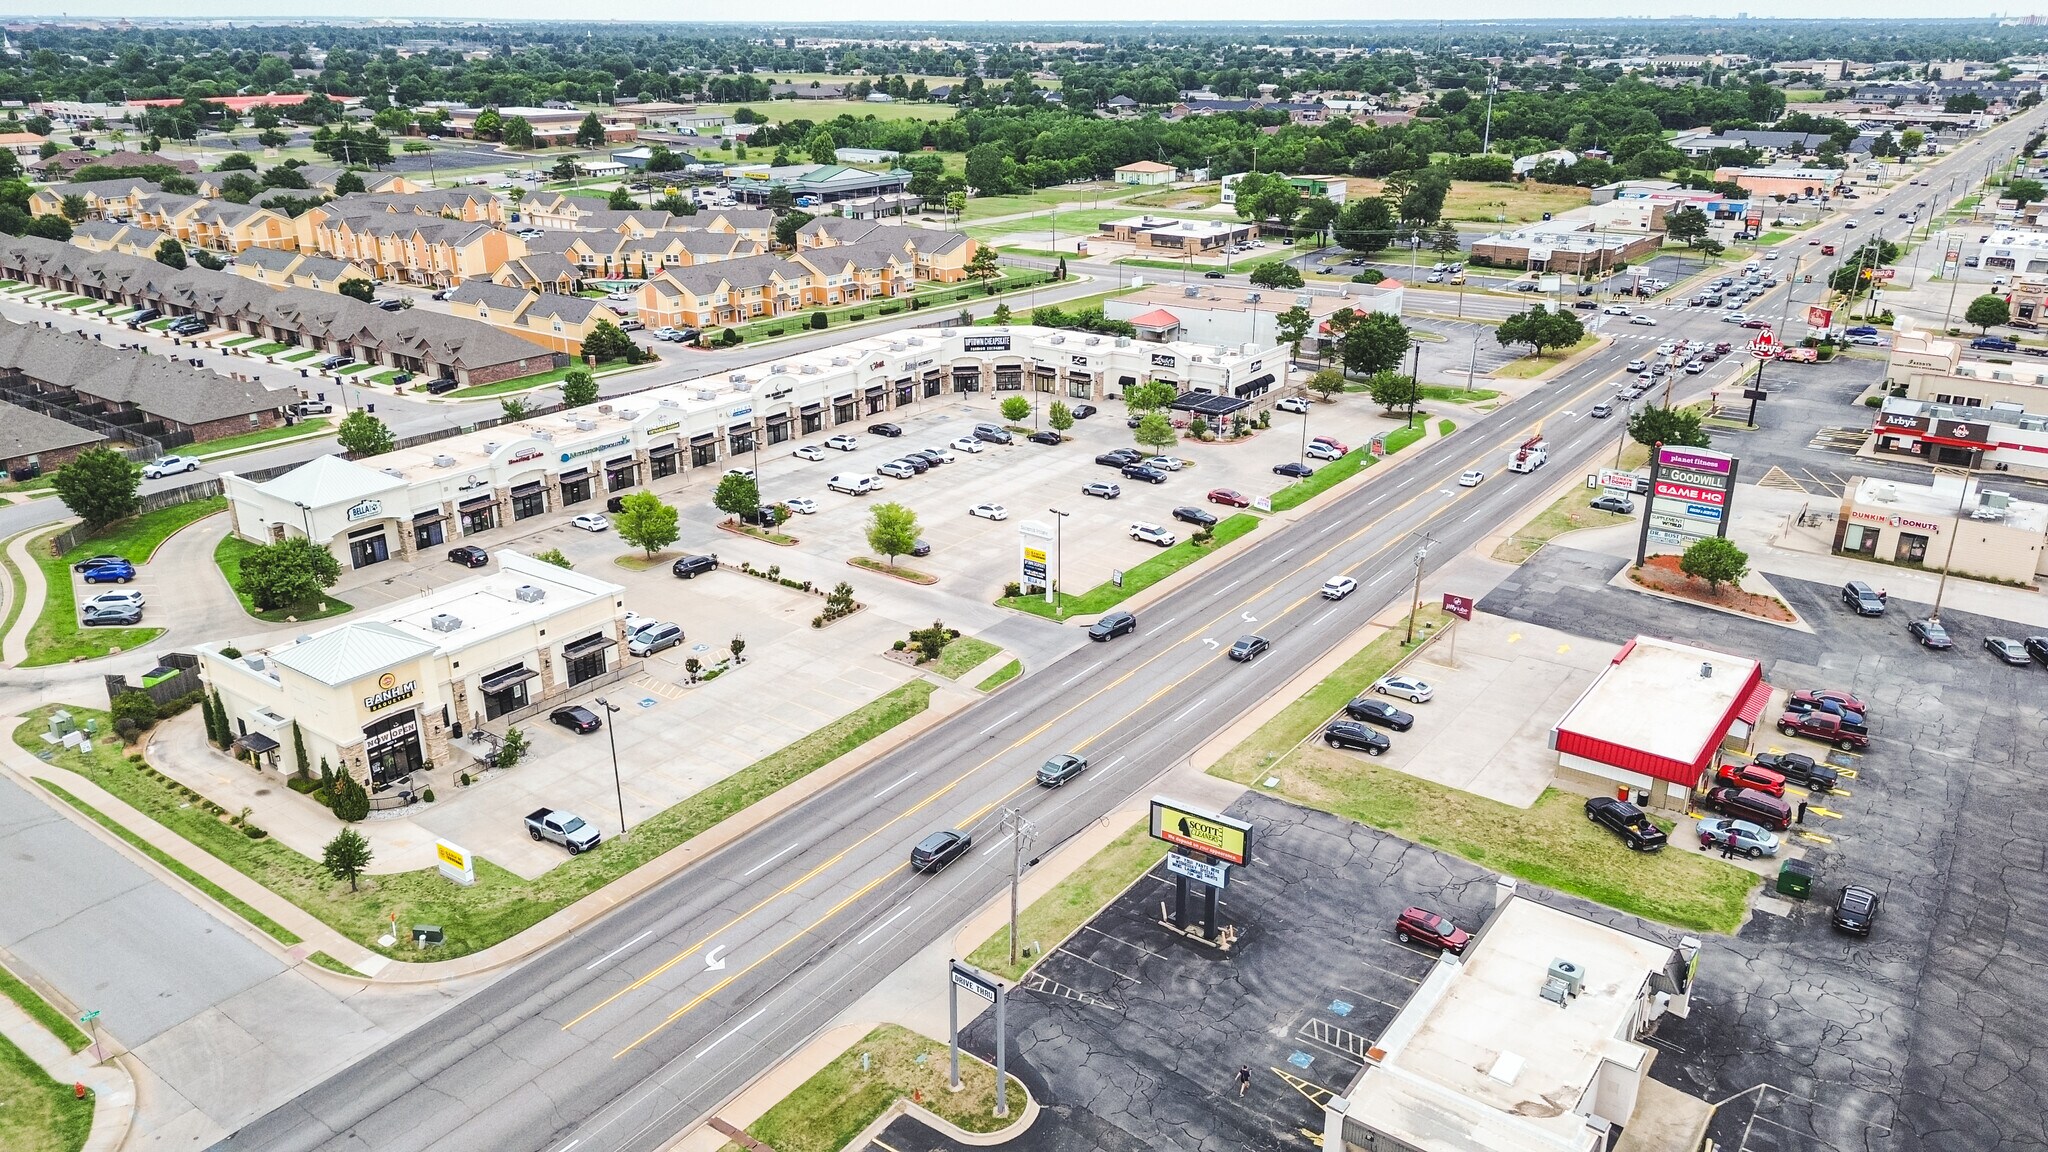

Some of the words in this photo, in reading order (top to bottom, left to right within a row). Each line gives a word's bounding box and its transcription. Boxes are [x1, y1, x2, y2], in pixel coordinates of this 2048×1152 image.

[1746, 340, 1782, 354] Arby's
[1886, 415, 1918, 427] Arby's
[1671, 455, 1693, 464] planet
[1694, 459, 1718, 468] fitness
[1671, 470, 1723, 487] GOODWILL
[1658, 485, 1699, 498] GAME
[1702, 492, 1722, 502] HQ
[352, 505, 369, 516] BELLA
[1652, 514, 1683, 523] SUPPLEMENT
[1903, 520, 1937, 530] DONUTS
[364, 686, 400, 708] BANH
[402, 680, 416, 693] MI
[372, 693, 410, 710] BAGUETTE
[367, 734, 389, 747] NOW
[393, 724, 414, 737] OPEN
[1190, 821, 1220, 836] SCOTT
[1191, 830, 1219, 843] CLEANERS
[955, 975, 973, 989] DRIVE
[976, 986, 992, 999] THRU
